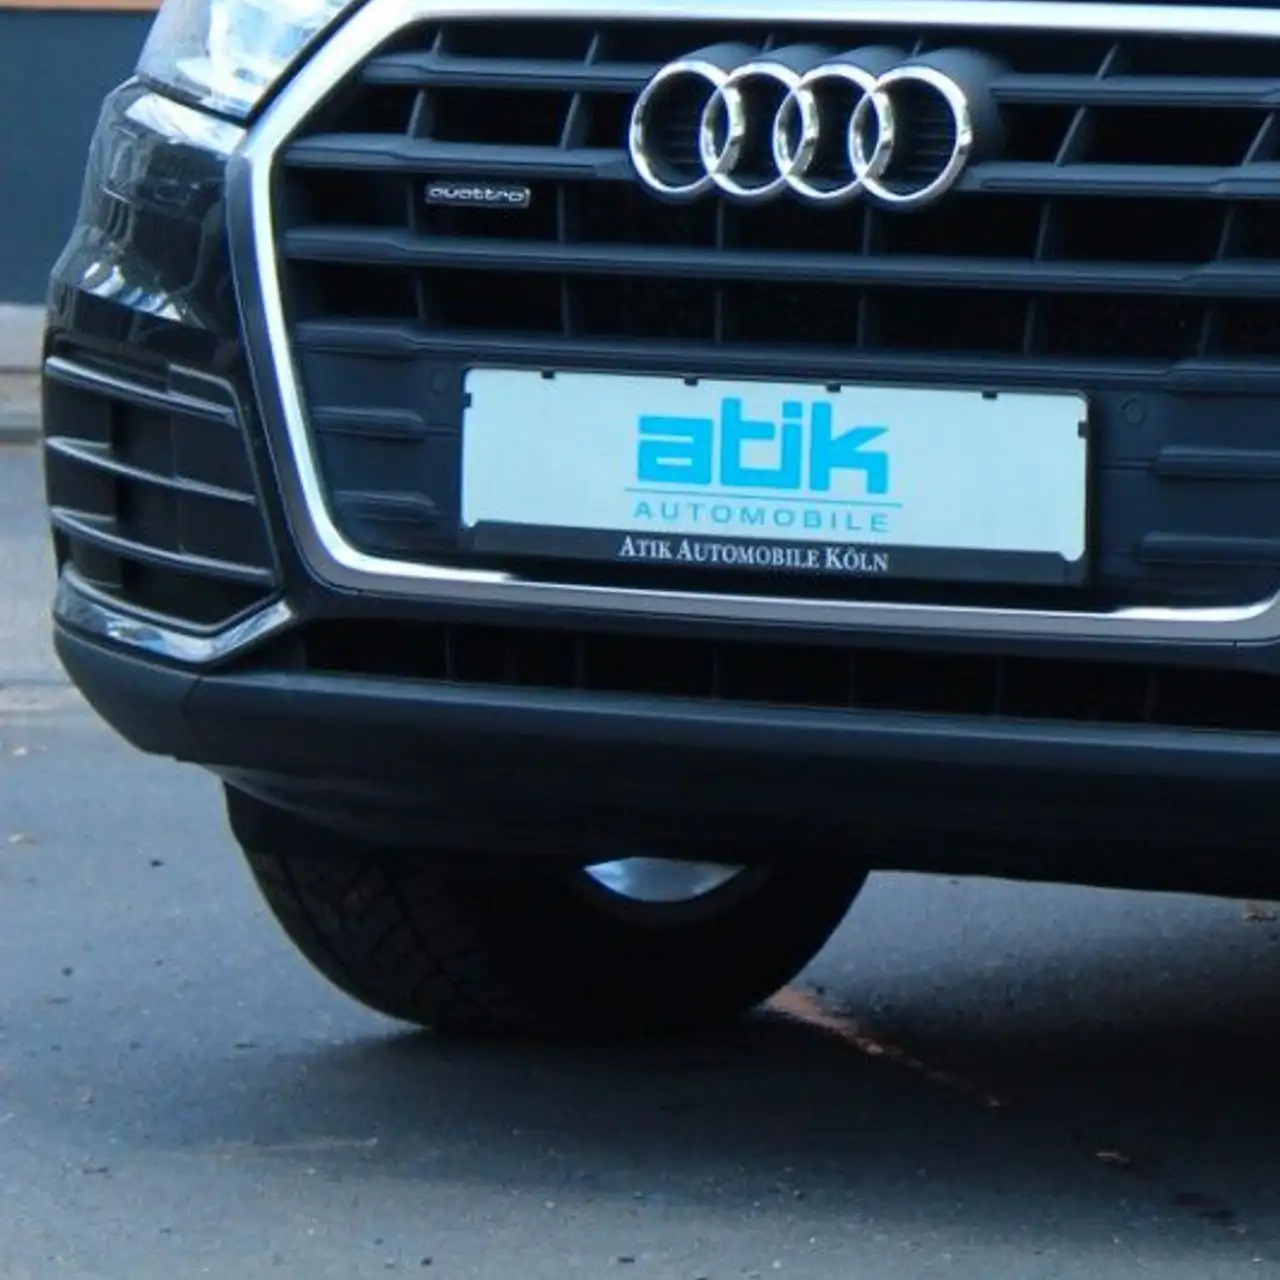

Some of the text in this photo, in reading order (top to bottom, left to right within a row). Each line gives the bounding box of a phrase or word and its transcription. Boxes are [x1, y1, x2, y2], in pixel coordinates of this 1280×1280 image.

[637, 397, 889, 494] atik
[633, 501, 889, 533] AUTOMOBILE
[619, 535, 889, 571] ATIK AUTOMOBILE KÖLN
